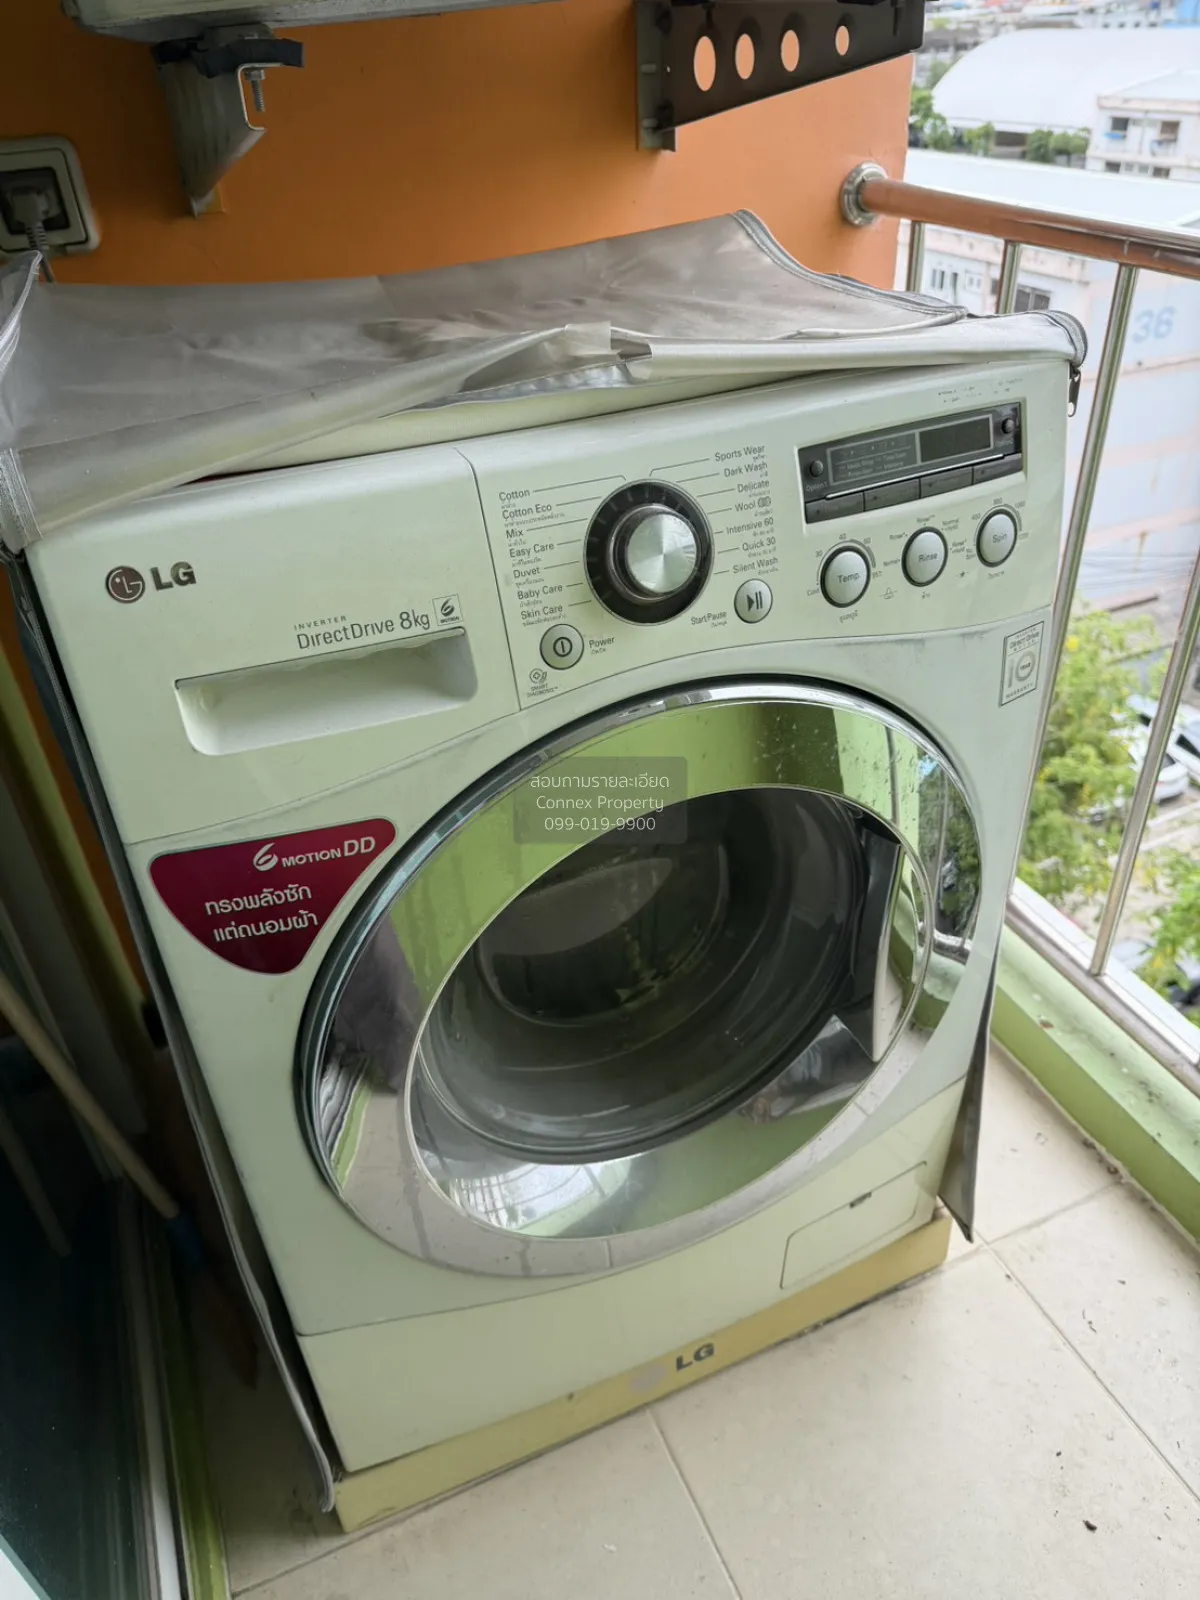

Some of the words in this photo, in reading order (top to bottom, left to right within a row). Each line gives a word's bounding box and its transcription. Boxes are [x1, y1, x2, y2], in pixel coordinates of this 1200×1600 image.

[1132, 306, 1177, 344] 36
[714, 450, 742, 462] Sports
[743, 445, 765, 455] Wear
[724, 467, 743, 477] Dark
[744, 461, 768, 472] Wash
[737, 480, 769, 493] Delicate
[499, 489, 530, 501] Cotton
[502, 507, 533, 519] Cotton
[535, 504, 552, 513] Eco
[735, 500, 756, 512] Wool
[726, 521, 762, 534] Intensive
[764, 517, 774, 526] 60
[506, 529, 523, 538] Mix
[510, 548, 531, 558] Easy
[533, 543, 554, 553] Care
[742, 540, 764, 551] Quick
[766, 536, 776, 546] 30
[918, 553, 938, 562] Rinse
[513, 567, 541, 579] Duvet
[733, 562, 756, 574] Silent
[757, 557, 779, 568] Wash
[150, 561, 196, 591] LG
[838, 572, 861, 583] Temp.
[518, 590, 540, 600] Baby
[542, 584, 563, 595] Care
[520, 609, 541, 620] Skin
[543, 605, 563, 615] Care
[293, 615, 348, 631] INVERTER
[588, 637, 615, 649] Power
[281, 848, 342, 868] MOTION
[343, 836, 376, 857] DD
[204, 883, 312, 916] ทรงพลังซัก
[213, 910, 319, 942] แต่ถนอมผ้า
[675, 1342, 715, 1371] LG
